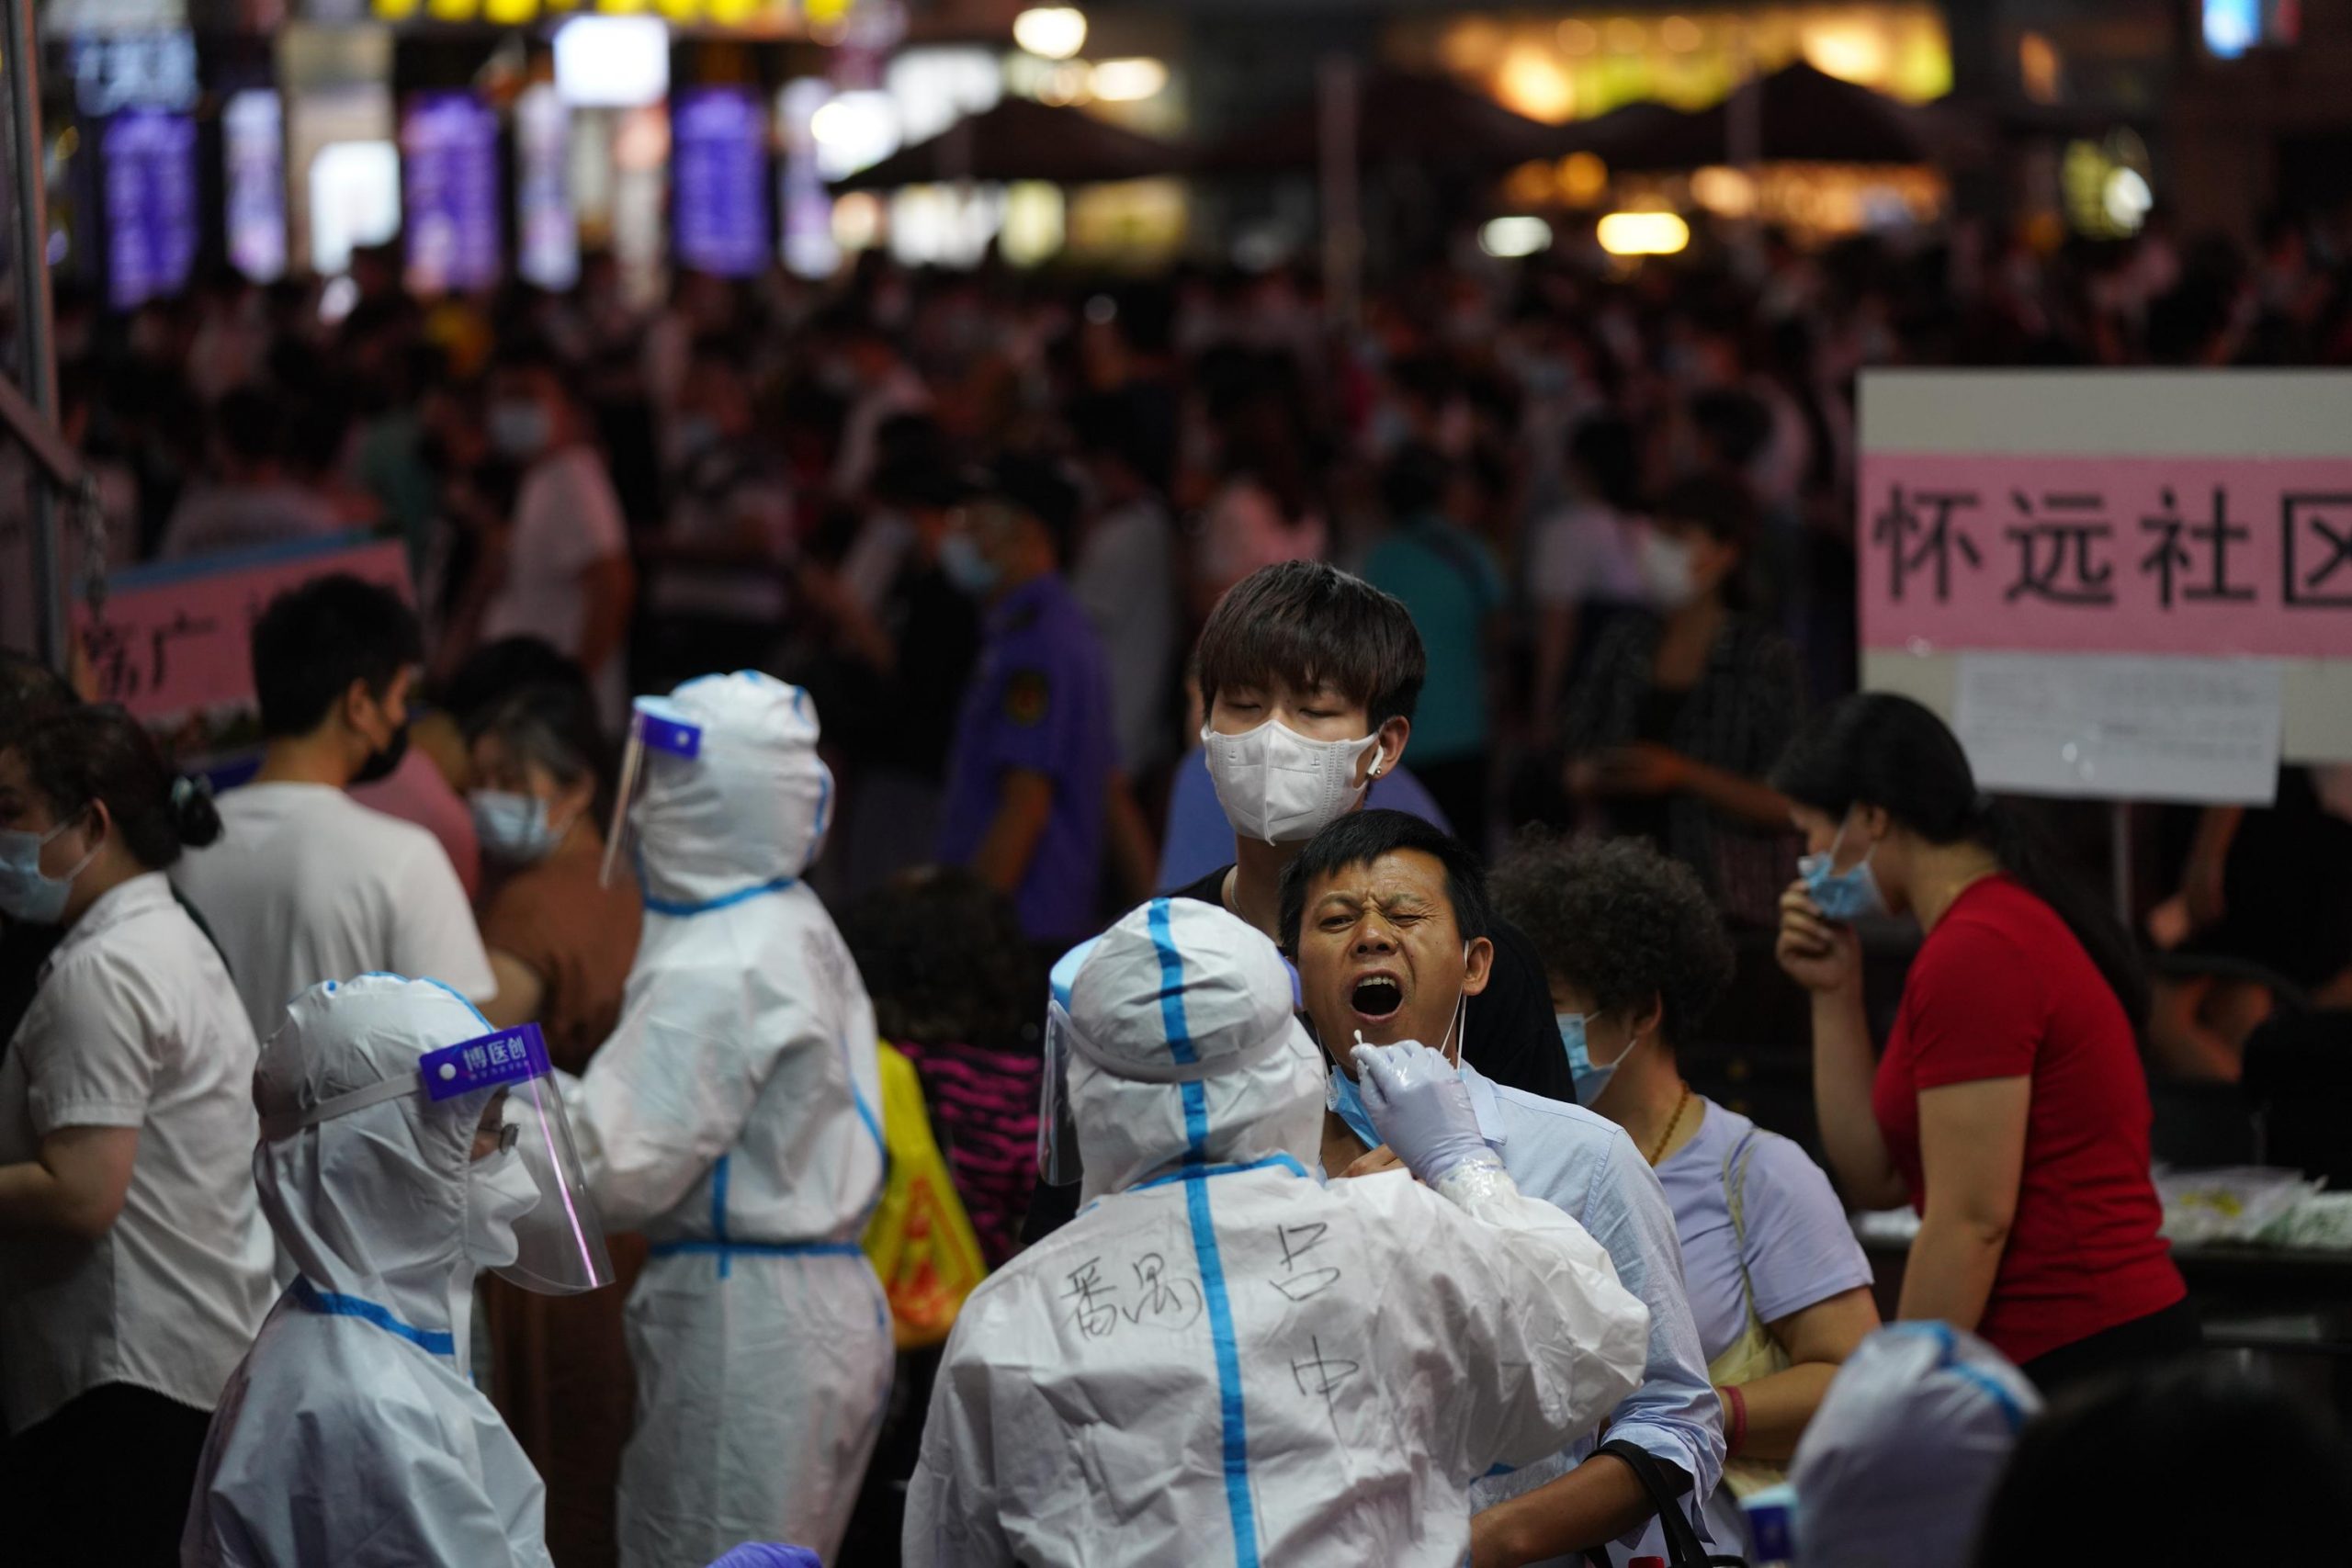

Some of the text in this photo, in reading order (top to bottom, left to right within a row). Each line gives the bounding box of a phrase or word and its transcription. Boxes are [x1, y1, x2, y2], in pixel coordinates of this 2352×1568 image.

[1873, 482, 2352, 609] 怀远社区
[463, 1036, 526, 1071] 博医创
